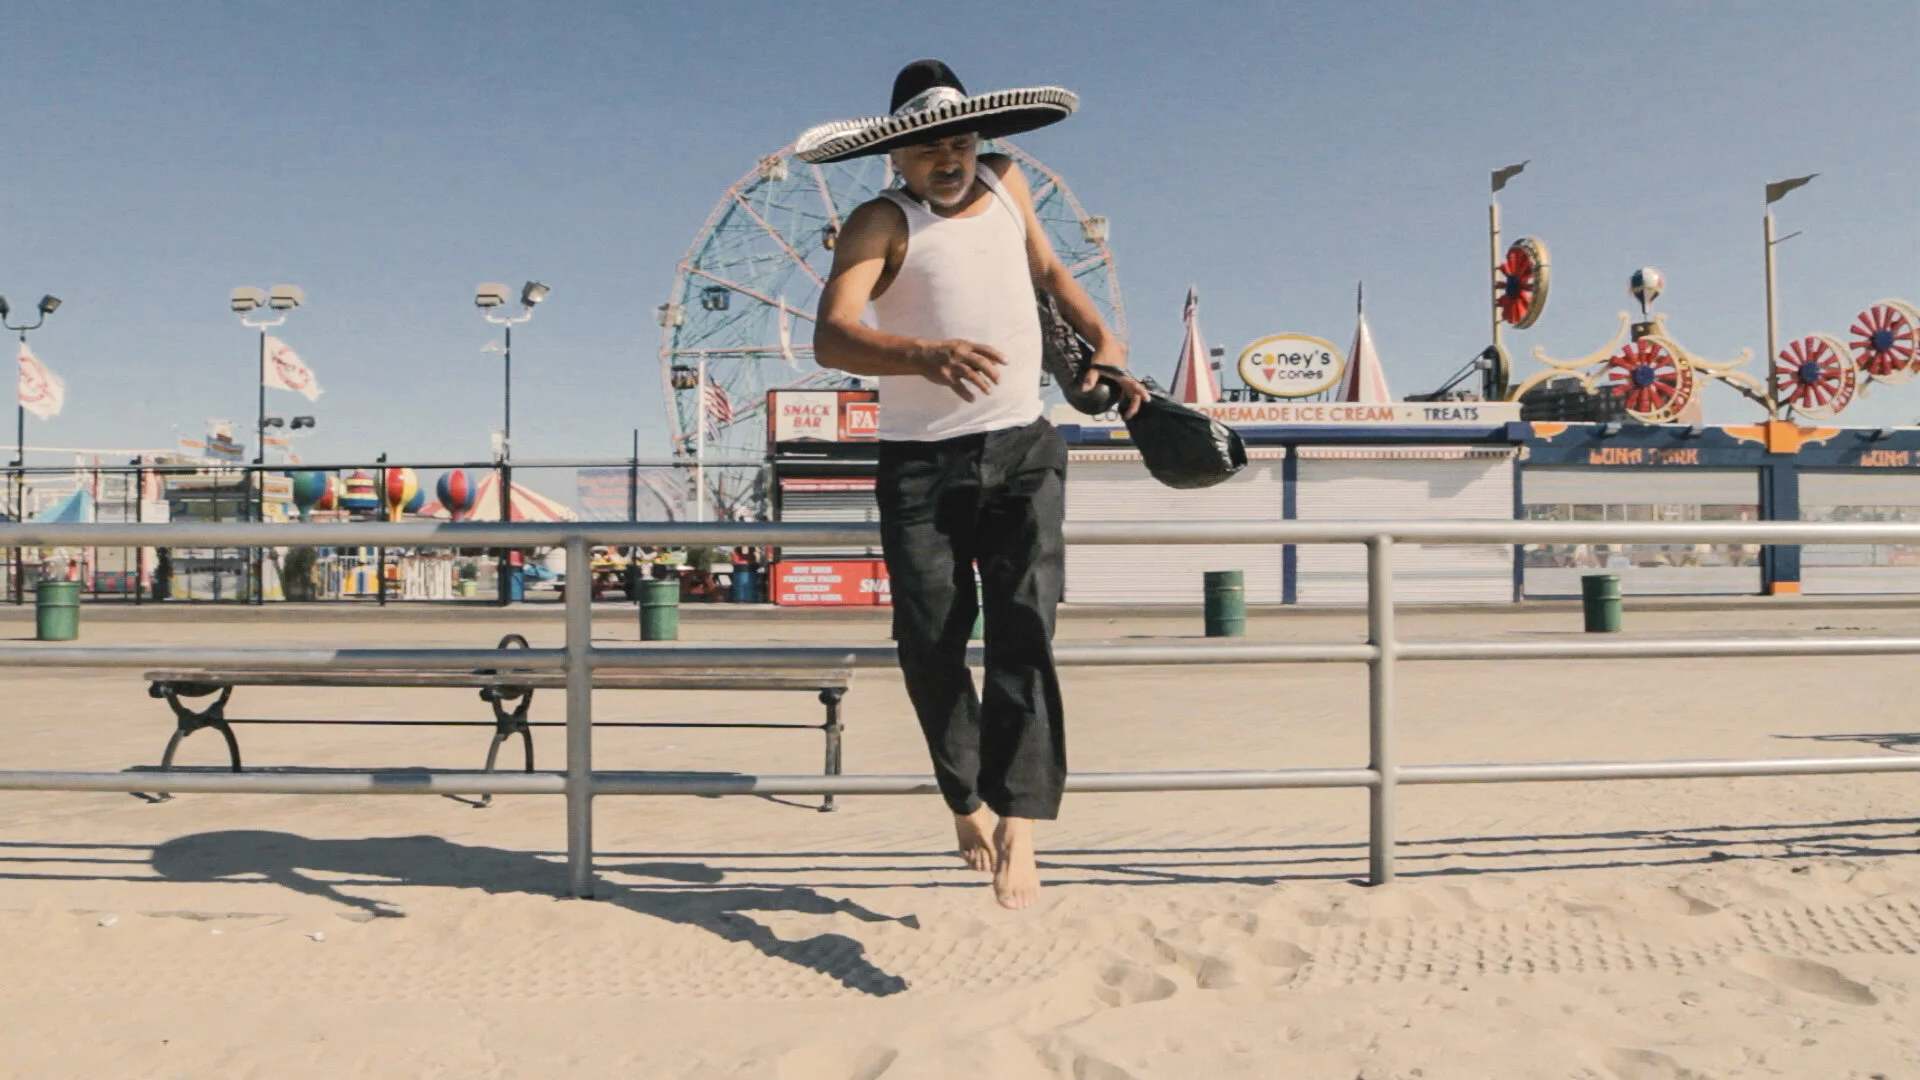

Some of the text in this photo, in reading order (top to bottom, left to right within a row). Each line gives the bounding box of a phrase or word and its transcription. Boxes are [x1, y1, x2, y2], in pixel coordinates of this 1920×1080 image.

[1251, 350, 1331, 368] coney's
[1278, 369, 1324, 380] cones
[783, 404, 832, 416] SNACK
[1296, 407, 1324, 421] ICE
[1330, 407, 1394, 421] CREAM
[1424, 407, 1480, 421] TREATS
[793, 417, 822, 427] BAR
[850, 410, 880, 429] FA
